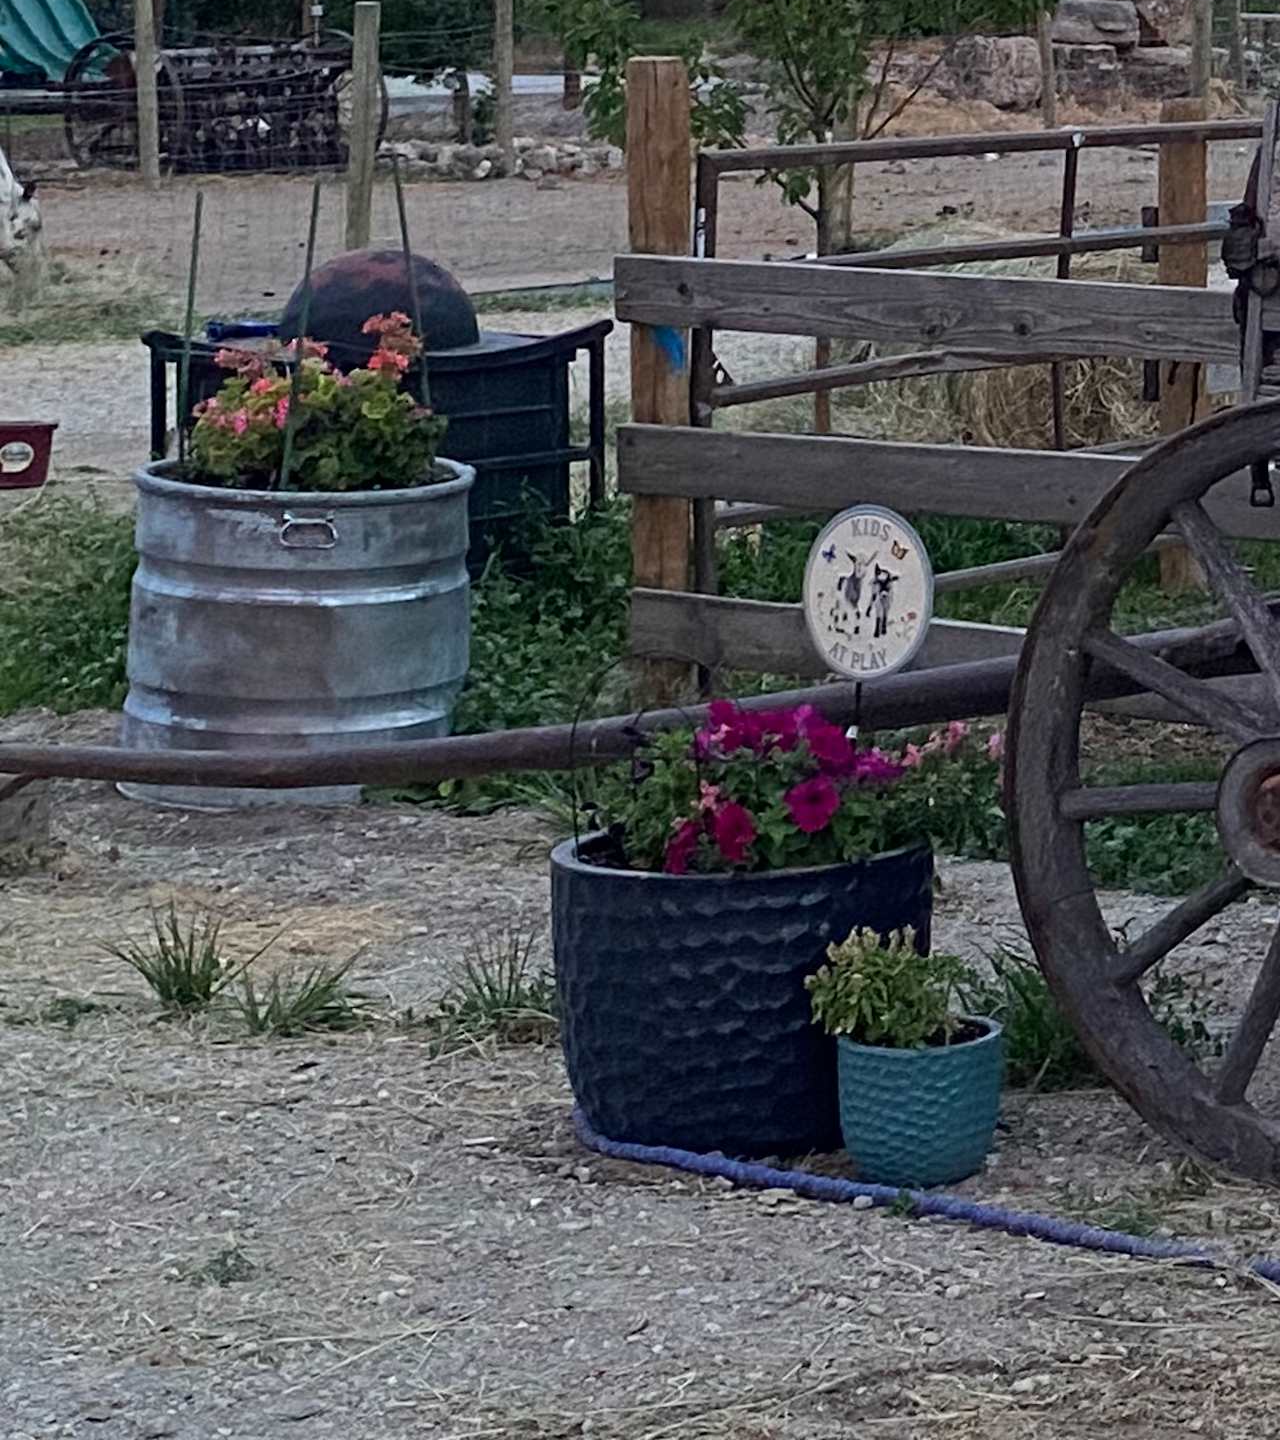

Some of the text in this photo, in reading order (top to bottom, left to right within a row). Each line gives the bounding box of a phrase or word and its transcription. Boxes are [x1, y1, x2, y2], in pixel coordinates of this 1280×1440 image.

[851, 518, 892, 542] KIDS
[828, 642, 888, 671] AT PLAY
